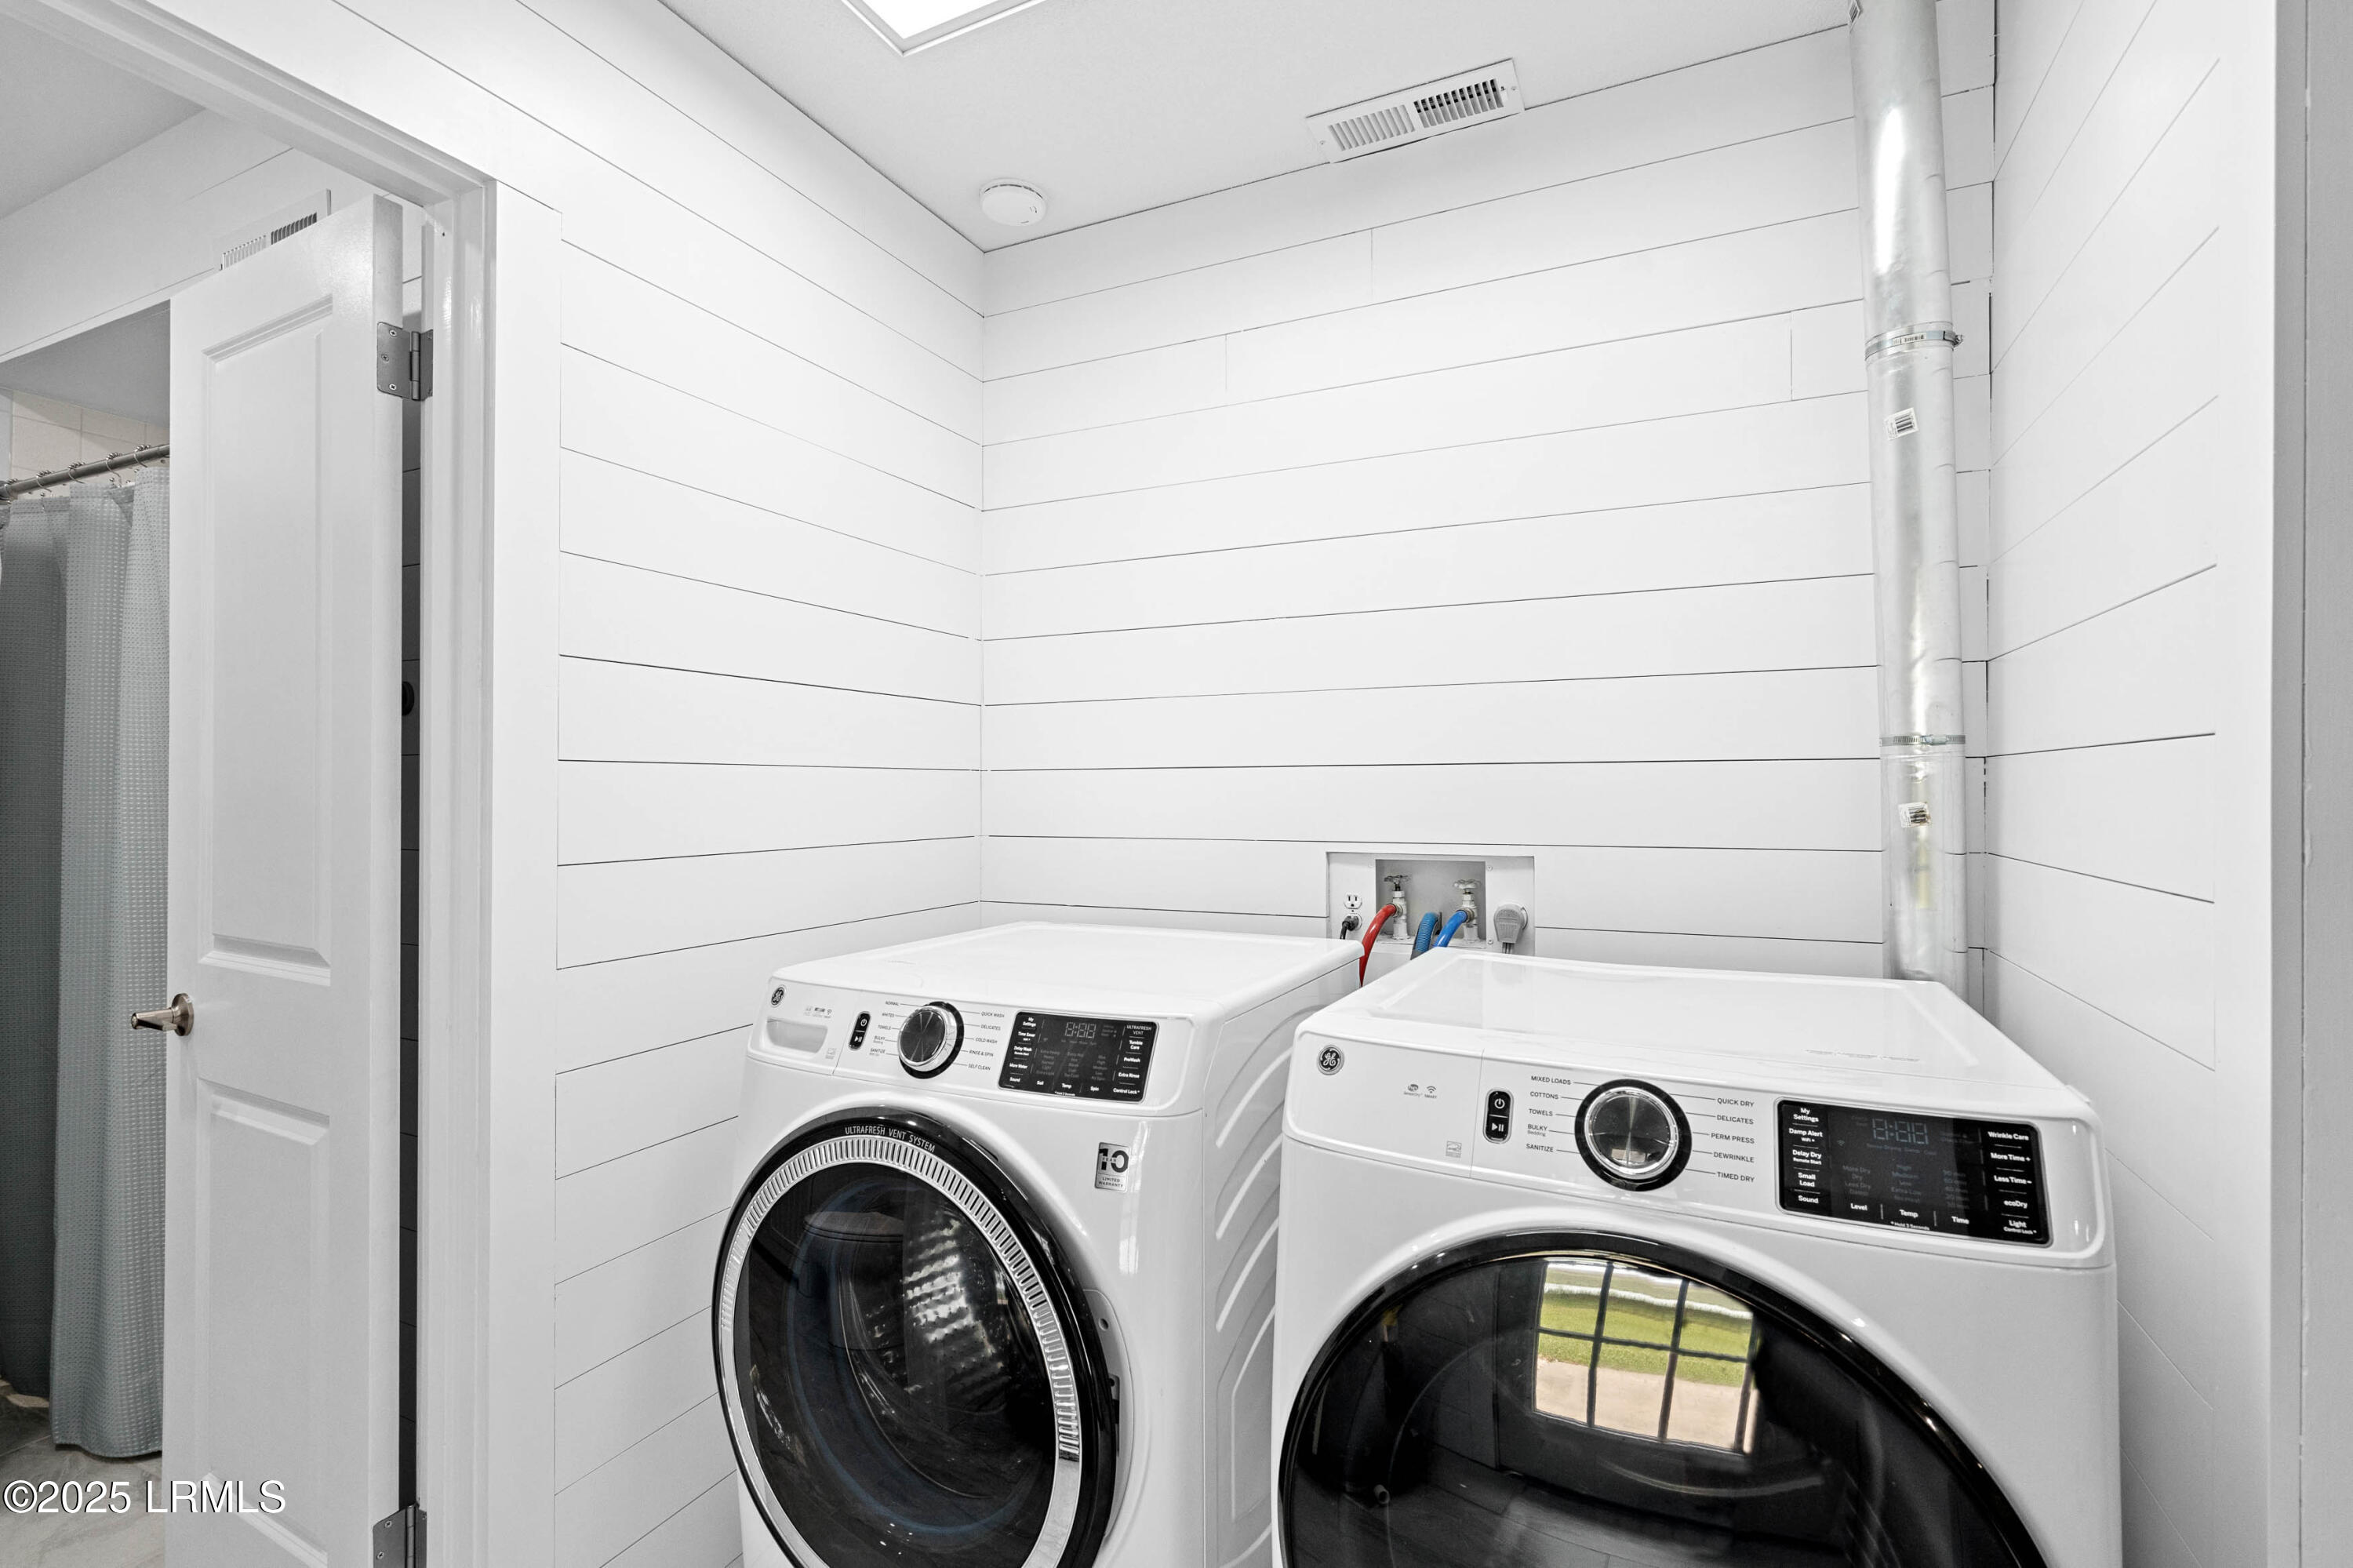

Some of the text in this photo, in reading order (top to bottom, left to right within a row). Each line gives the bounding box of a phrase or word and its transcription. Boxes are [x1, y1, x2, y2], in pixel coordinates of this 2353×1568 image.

[1529, 1091, 1559, 1100] COTTONS
[1529, 1108, 1553, 1117] TOWELS
[1800, 1107, 1810, 1115] My
[1717, 1114, 1754, 1125] DELICATES
[1793, 1114, 1819, 1122] Settings
[1789, 1128, 1807, 1137] Damp
[1988, 1130, 2013, 1139] Wrinkle
[845, 1125, 936, 1154] ULTRAFRESH VENT SYSTEM
[1711, 1132, 1755, 1144] PERM PRESS
[1526, 1143, 1554, 1153] SANITIZE
[1713, 1151, 1755, 1163] DEWRINKLE
[1792, 1149, 1809, 1158] Delay
[1098, 1148, 1129, 1173] 10
[1717, 1171, 1739, 1181] TIMED
[1993, 1174, 2009, 1183] Less
[2009, 1176, 2027, 1184] Time
[1798, 1195, 1819, 1204] Sound
[1850, 1202, 1867, 1211] Level
[2003, 1200, 2028, 1209] ecoDry
[1899, 1208, 1918, 1219] Temp
[1951, 1215, 1970, 1224] Time
[2008, 1219, 2028, 1228] Light
